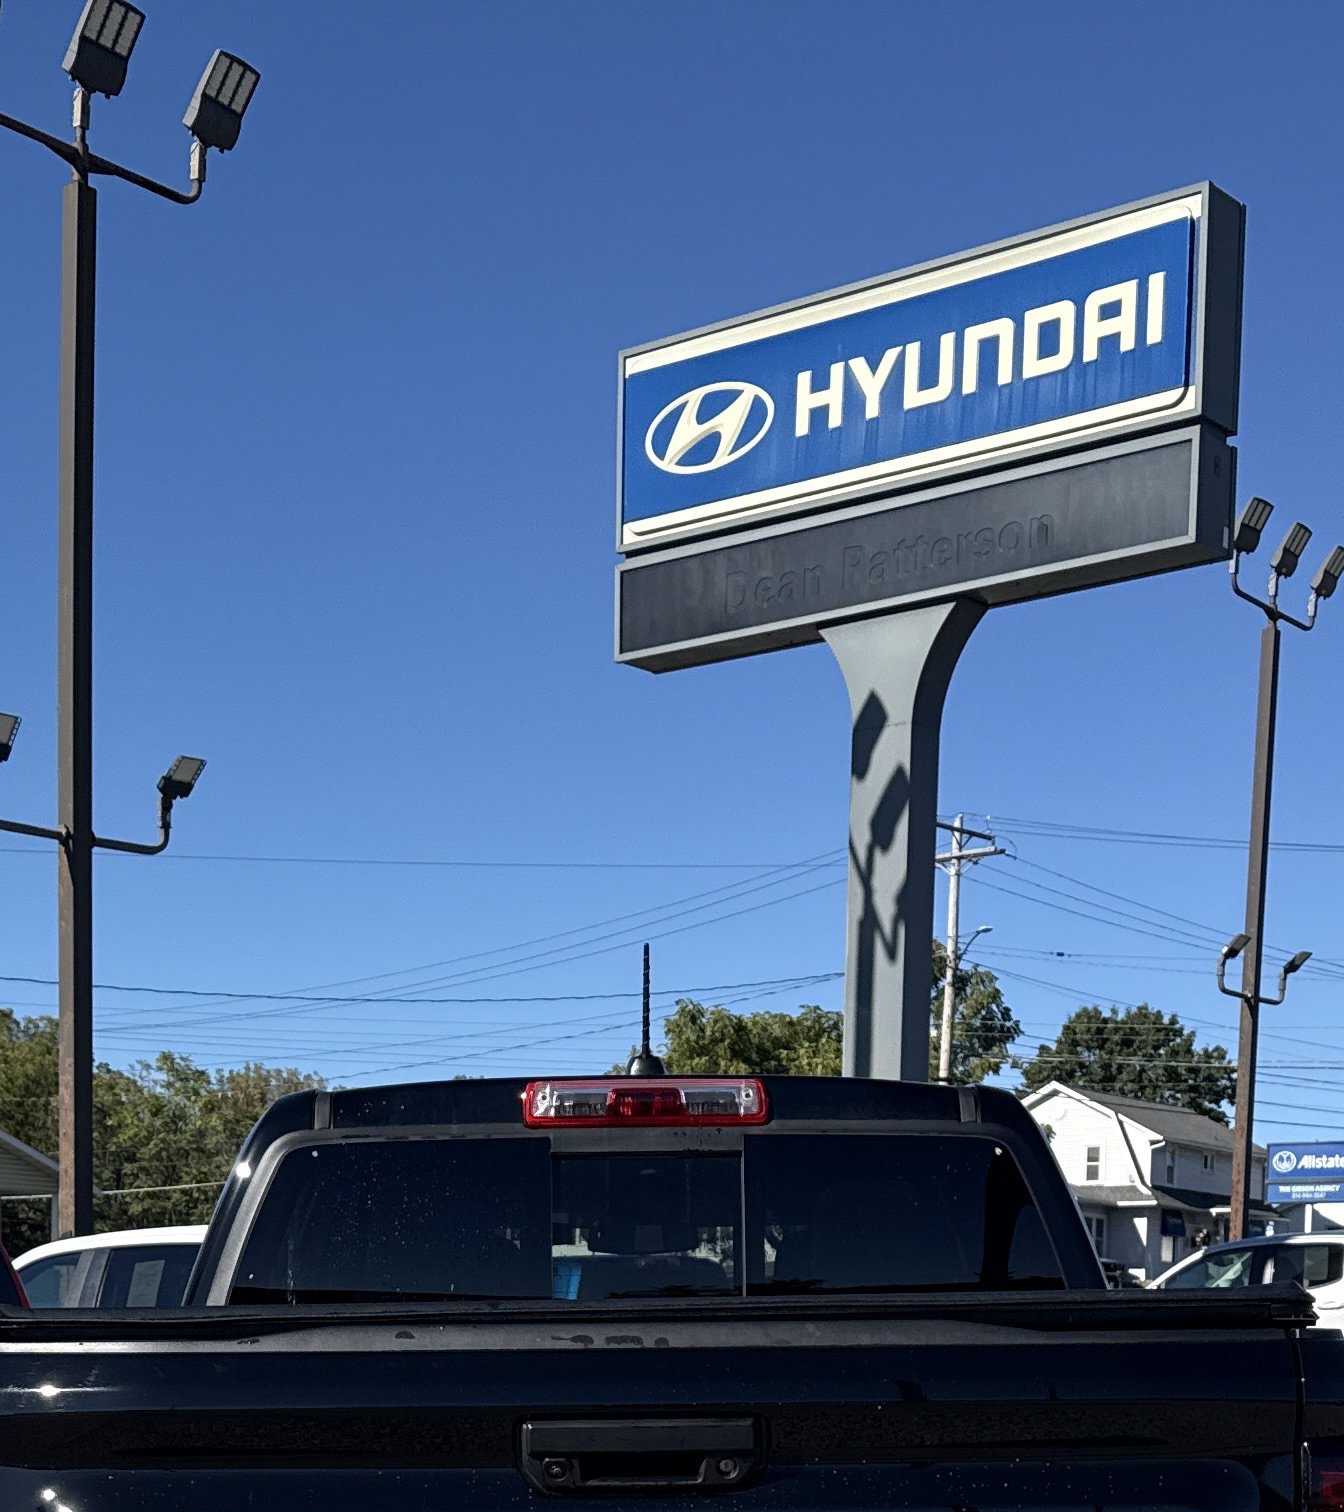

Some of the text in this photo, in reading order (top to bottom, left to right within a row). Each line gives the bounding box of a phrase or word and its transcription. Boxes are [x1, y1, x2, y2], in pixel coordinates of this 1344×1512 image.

[795, 271, 1166, 438] HYUNDAI
[724, 512, 1056, 617] Dean Patterson
